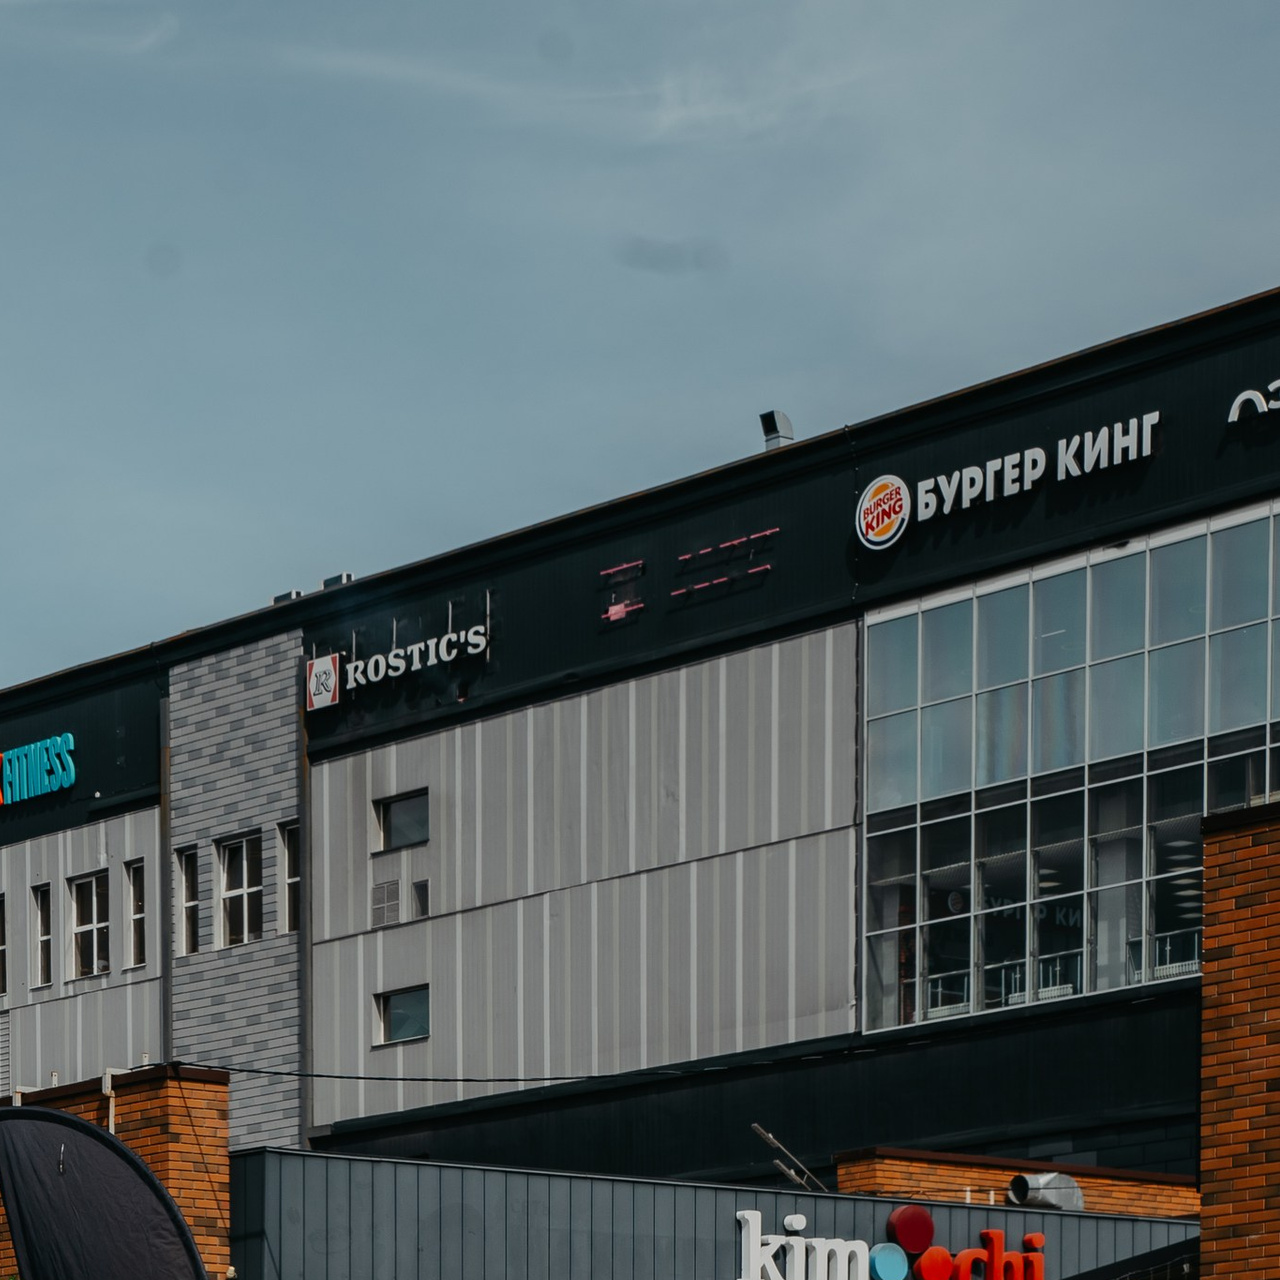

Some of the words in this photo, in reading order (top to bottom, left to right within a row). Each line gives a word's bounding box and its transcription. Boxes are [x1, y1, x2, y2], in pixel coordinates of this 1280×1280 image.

[916, 446, 1047, 522] БУРГЕР
[1056, 410, 1161, 481] КИНГ
[863, 485, 902, 521] BURGER
[864, 497, 904, 540] KING
[345, 624, 488, 691] ROSTIC'S
